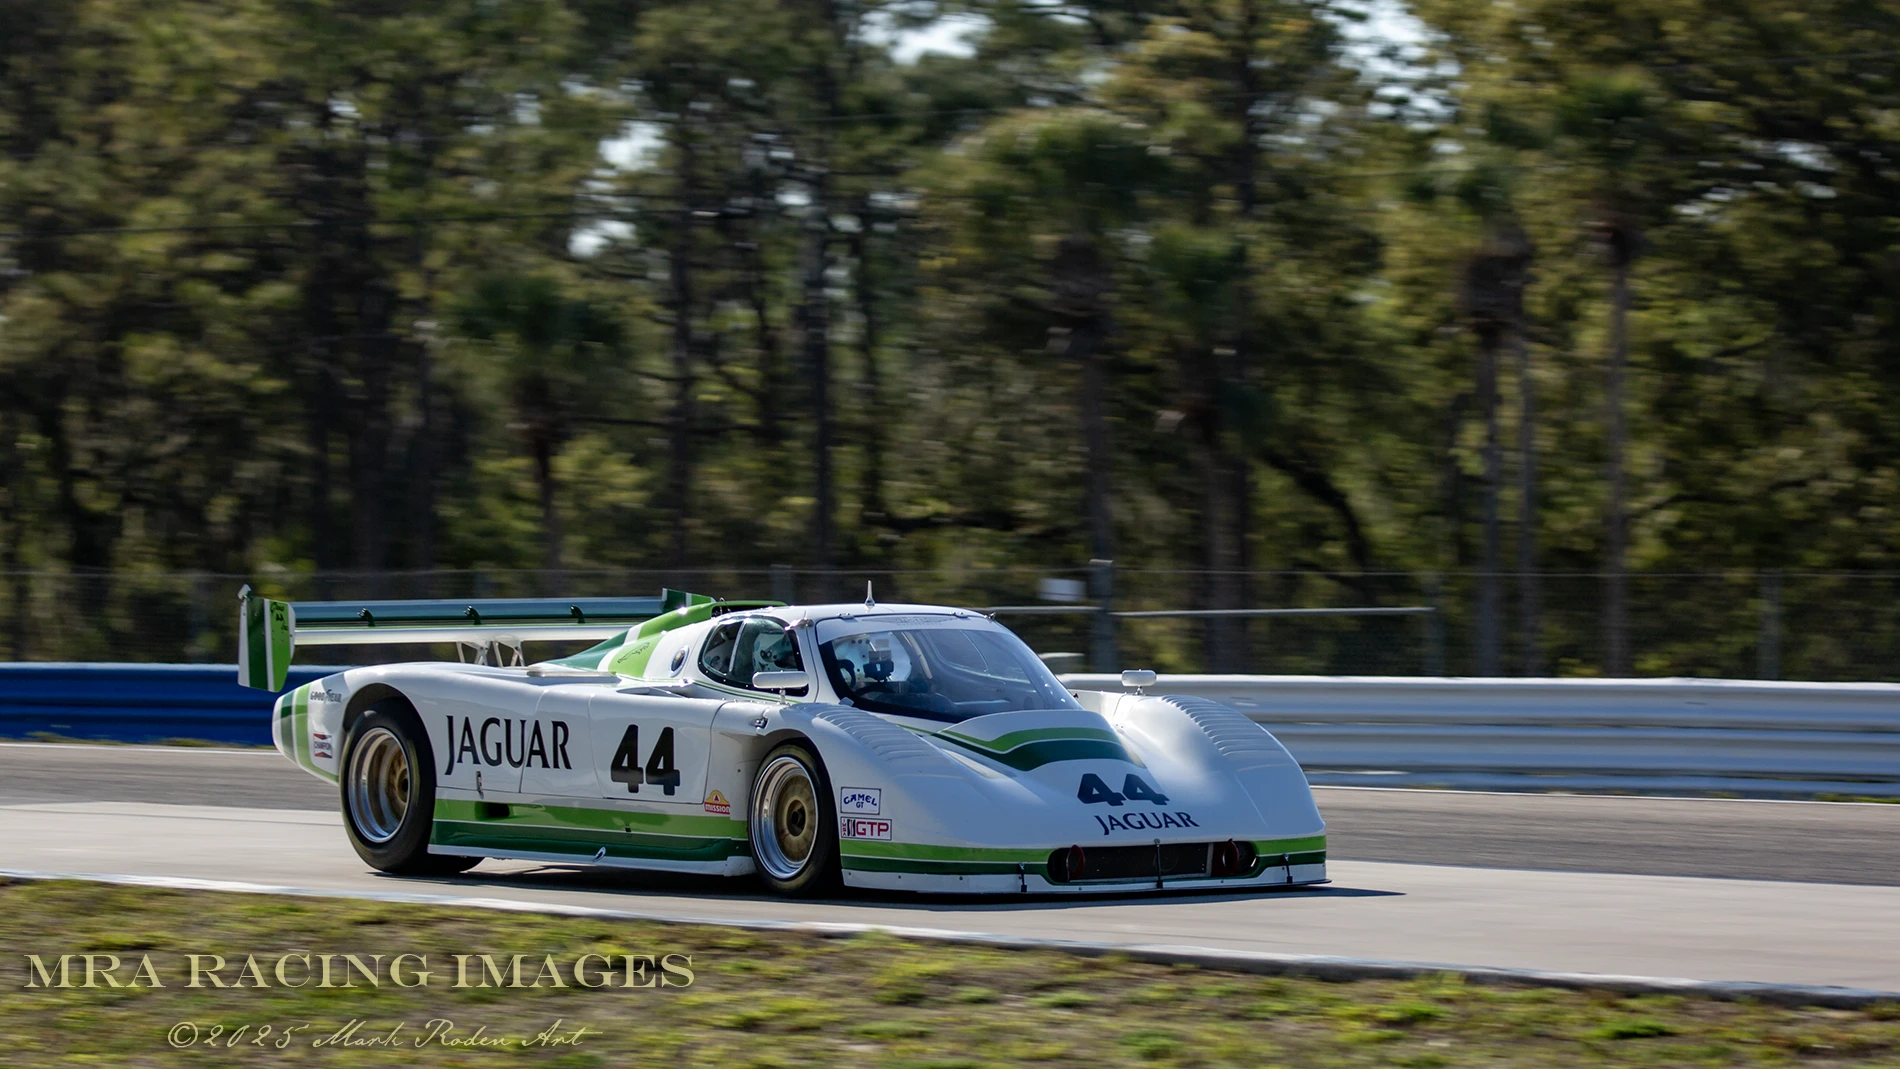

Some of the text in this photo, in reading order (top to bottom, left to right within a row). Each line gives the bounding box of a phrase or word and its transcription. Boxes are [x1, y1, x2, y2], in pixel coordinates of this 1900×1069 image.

[444, 715, 573, 775] JAGUAR
[610, 724, 681, 796] 44
[843, 794, 877, 806] CAMEL
[1077, 773, 1170, 806] 44
[856, 820, 889, 837] GTP
[1095, 811, 1200, 836] JAGUAR
